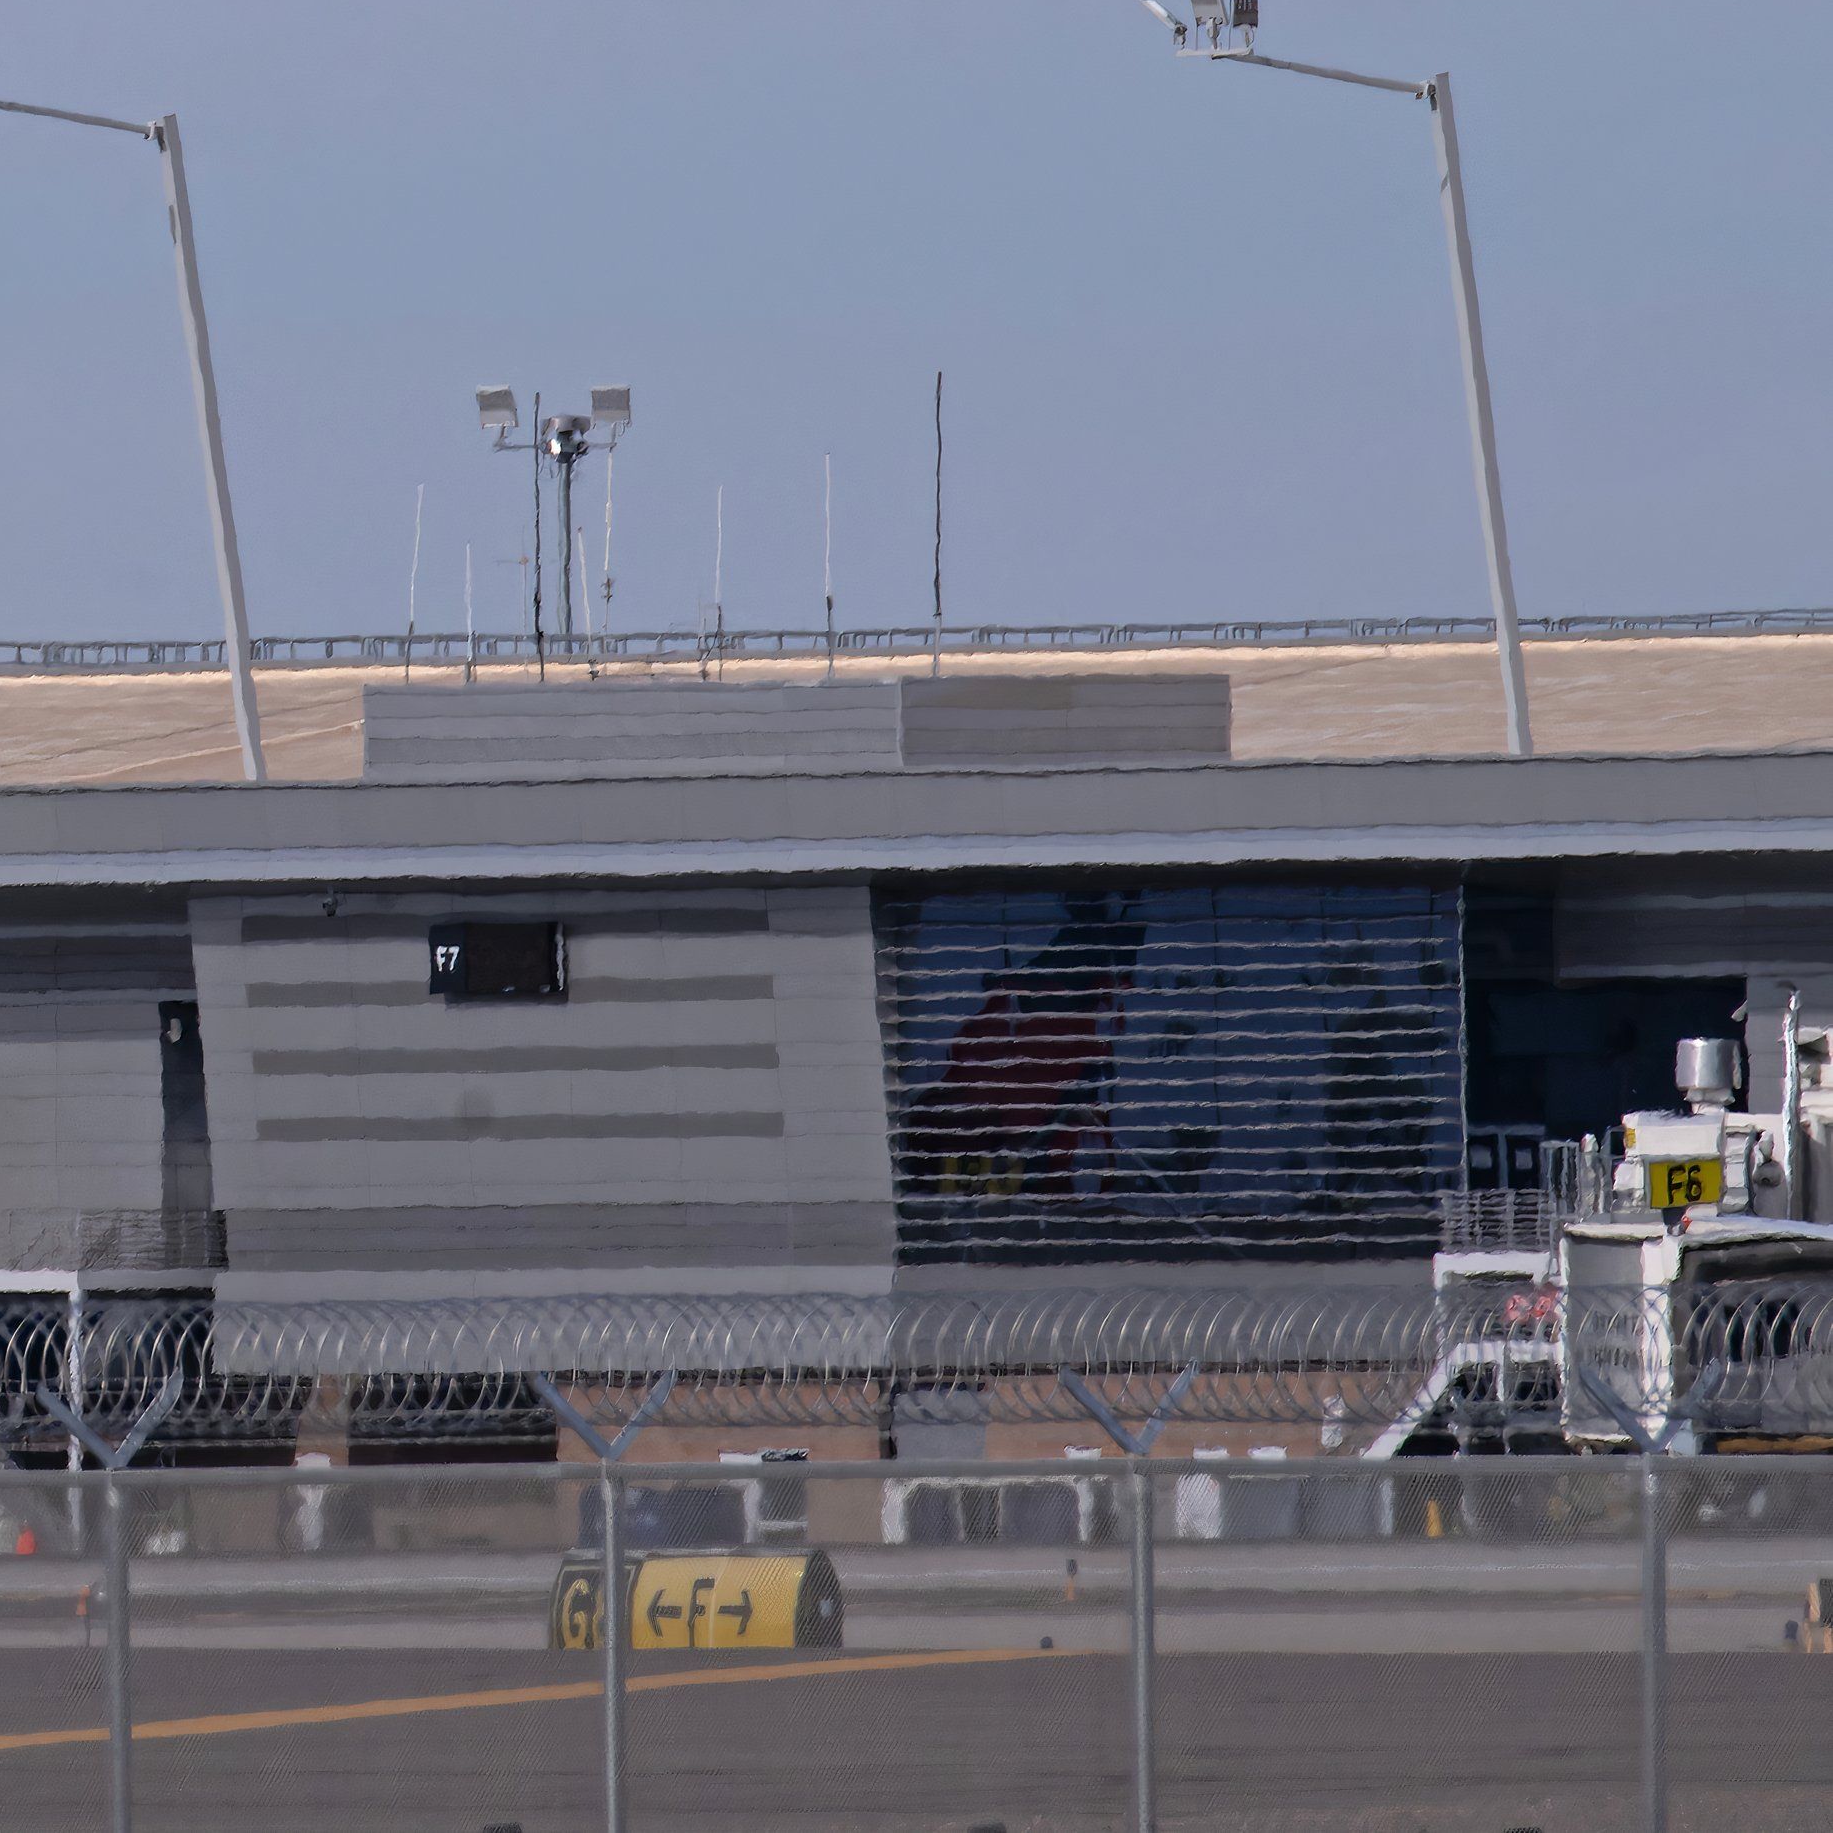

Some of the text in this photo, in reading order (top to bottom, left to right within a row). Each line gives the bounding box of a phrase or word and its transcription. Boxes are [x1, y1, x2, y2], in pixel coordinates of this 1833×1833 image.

[436, 945, 460, 972] F7
[1668, 1165, 1702, 1205] F6
[687, 1577, 715, 1647] F
